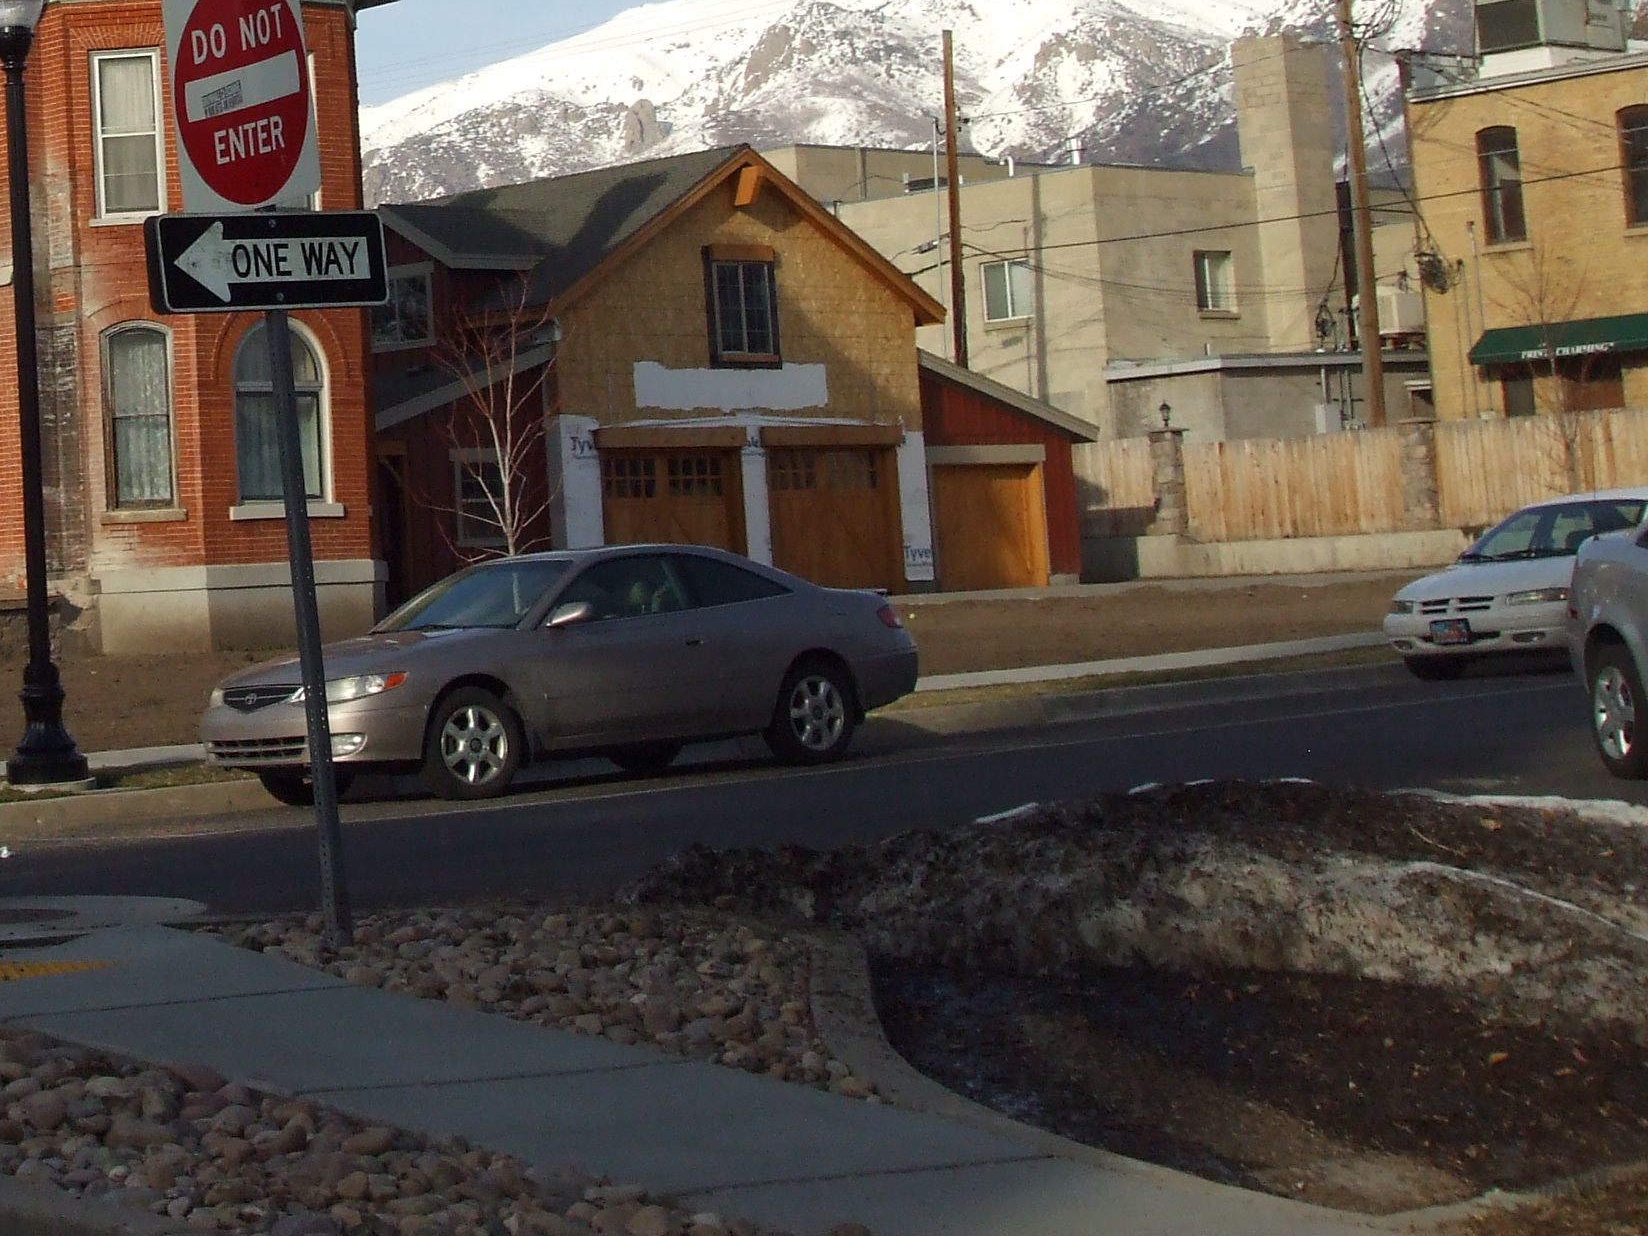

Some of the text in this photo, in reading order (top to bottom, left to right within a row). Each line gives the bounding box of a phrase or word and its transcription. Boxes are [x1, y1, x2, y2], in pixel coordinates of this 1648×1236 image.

[190, 3, 282, 65] DO NOT
[214, 115, 285, 165] ENTER
[232, 241, 360, 278] ONE WAY
